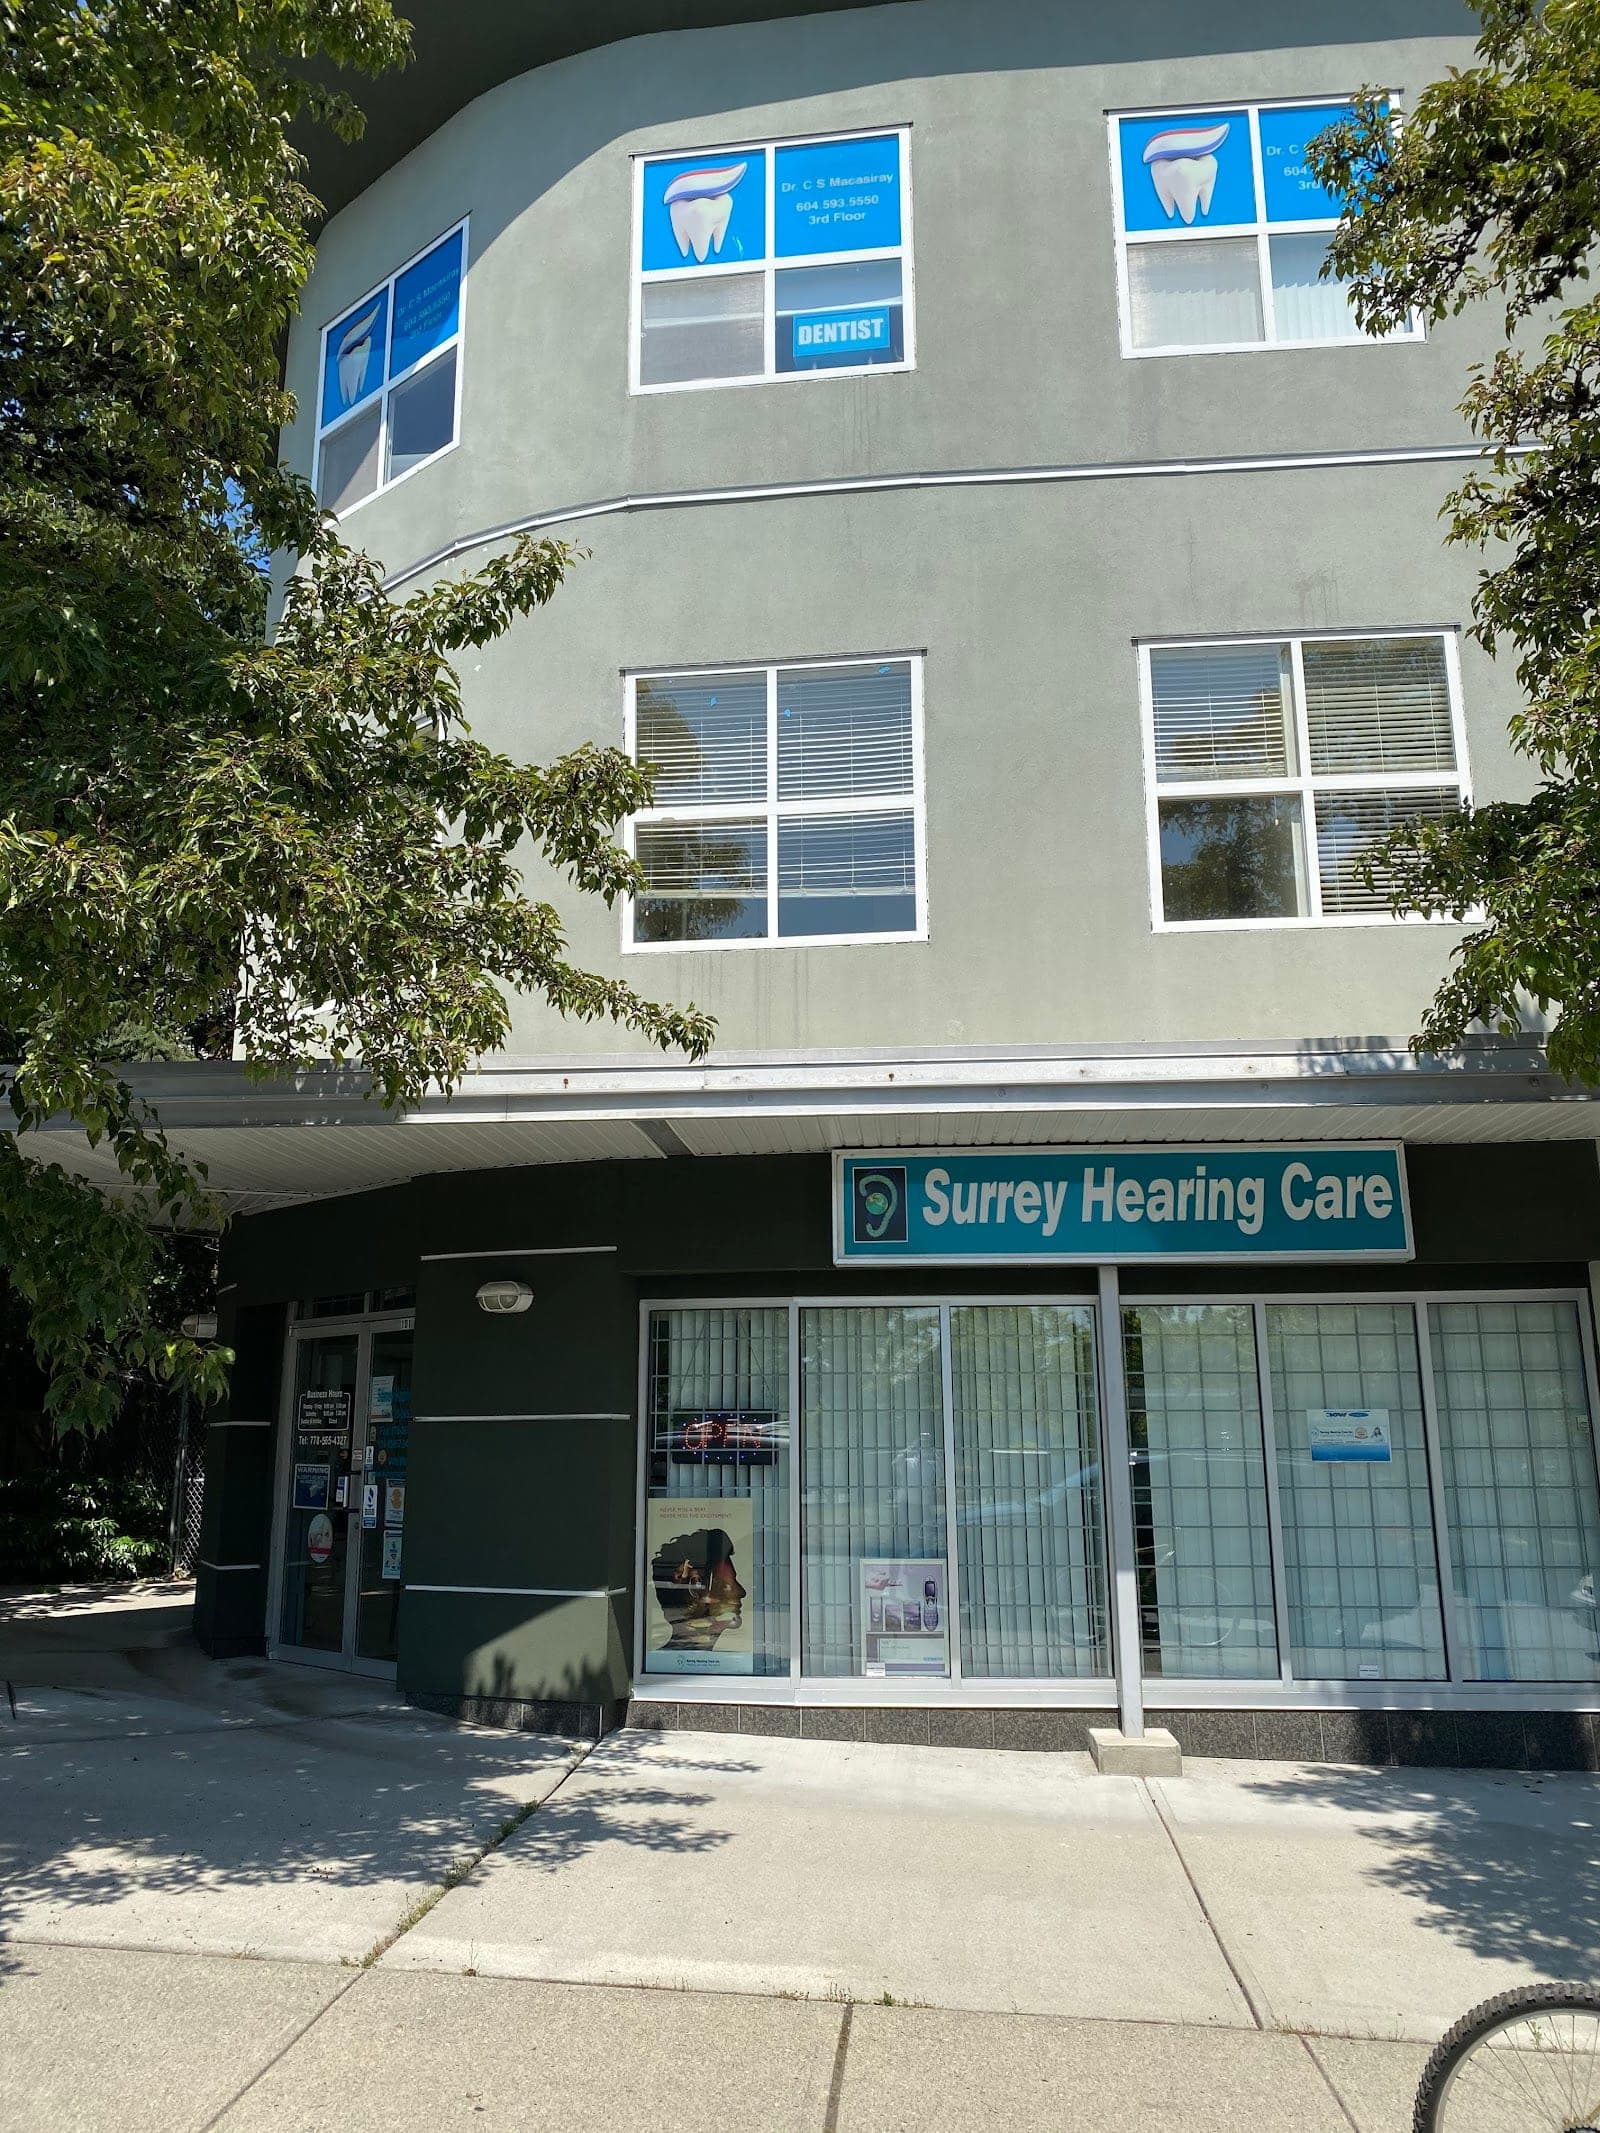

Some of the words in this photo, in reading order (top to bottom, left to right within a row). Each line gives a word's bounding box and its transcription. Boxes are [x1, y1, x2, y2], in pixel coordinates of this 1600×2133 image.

[802, 180, 813, 190] C
[816, 178, 826, 189] S
[808, 213, 830, 225] 3rd
[833, 211, 867, 222] Floor
[798, 318, 884, 346] DENTIST
[922, 1167, 1068, 1237] Surrey
[1081, 1165, 1265, 1236] Hearing
[1280, 1161, 1393, 1220] Care
